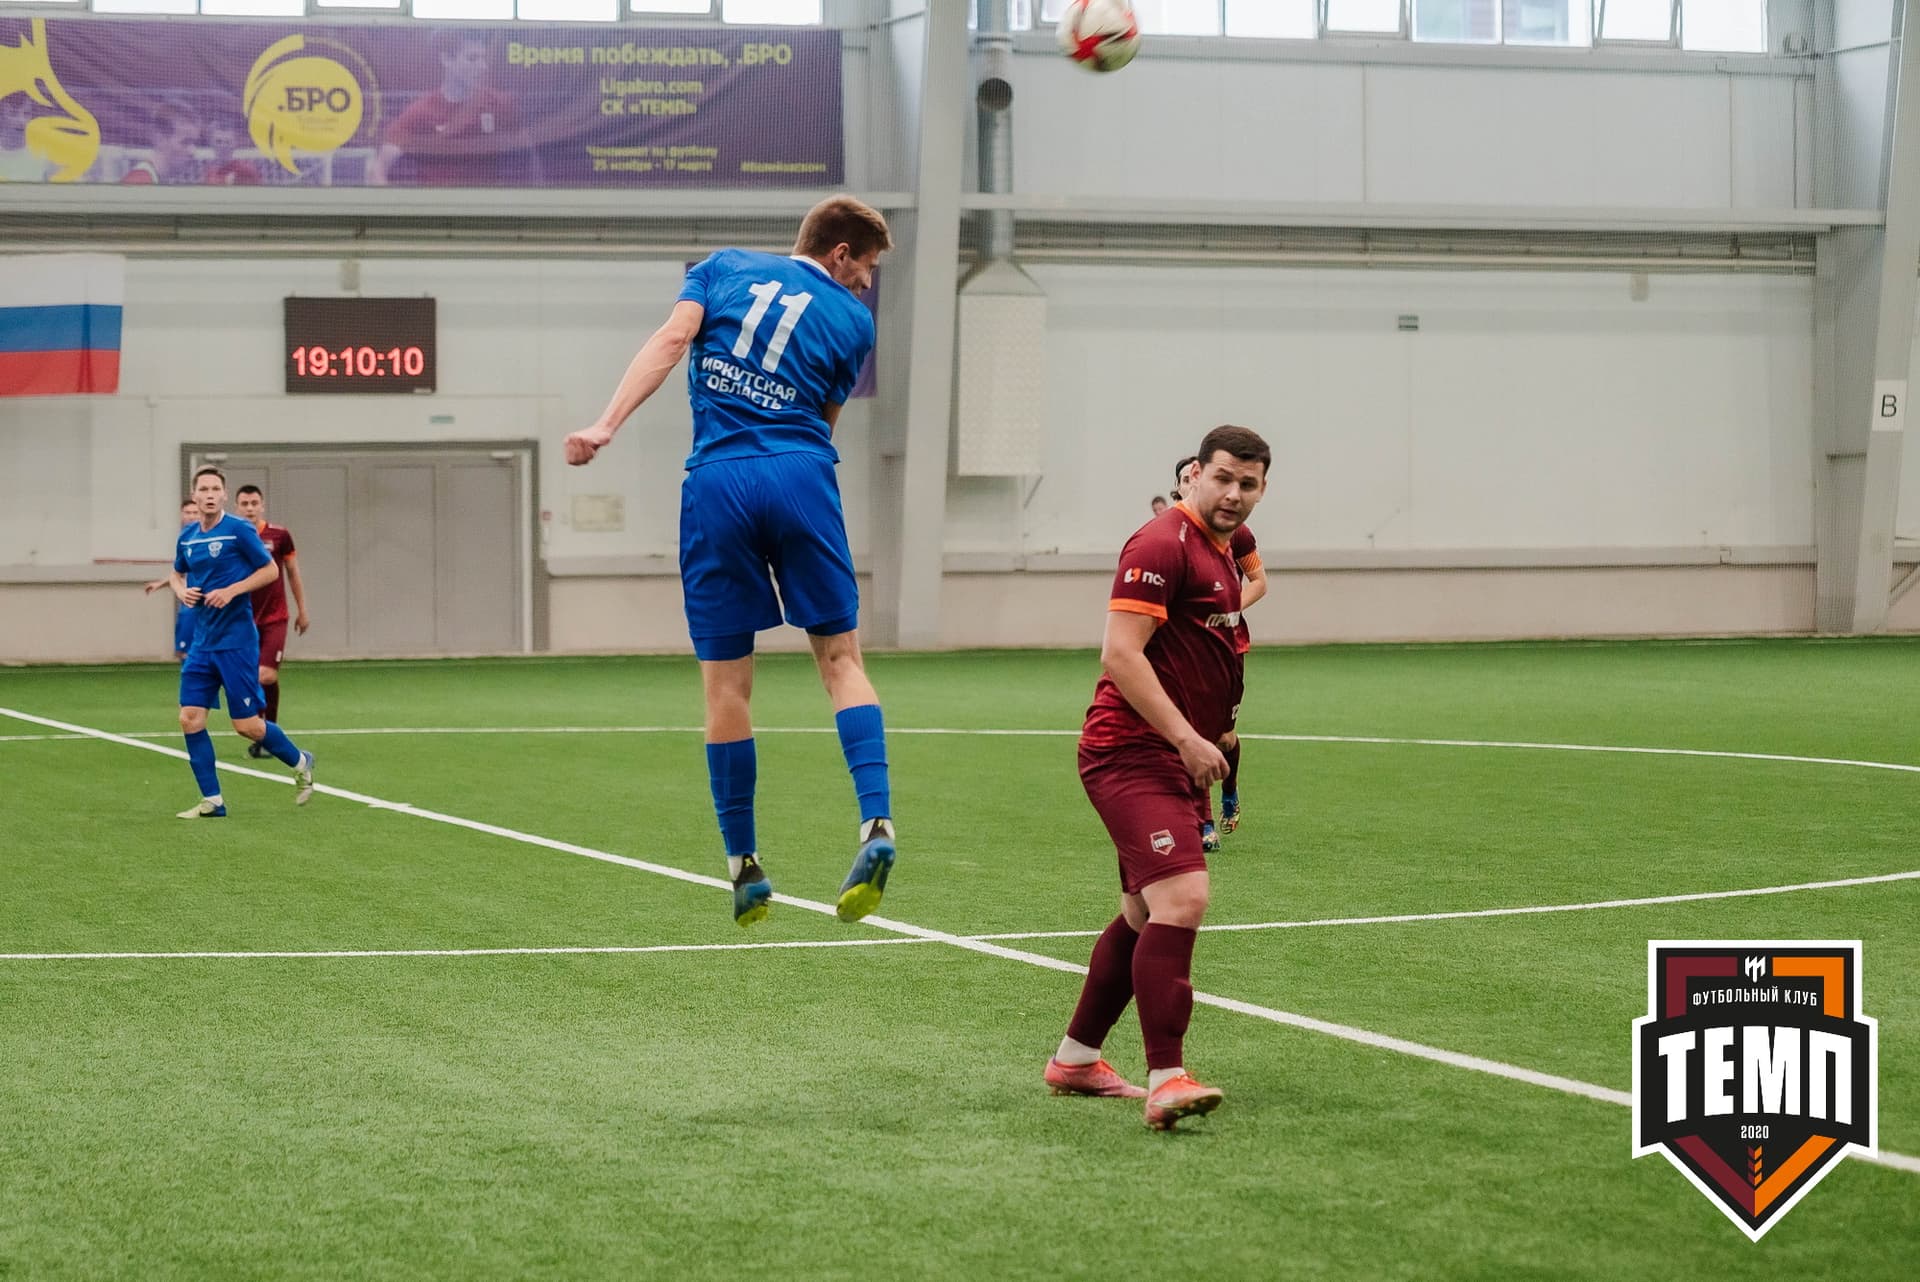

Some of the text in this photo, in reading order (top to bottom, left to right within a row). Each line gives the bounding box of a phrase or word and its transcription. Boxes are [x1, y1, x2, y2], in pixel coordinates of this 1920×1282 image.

[508, 43, 584, 68] Время
[592, 42, 729, 68] побеждать,
[278, 86, 351, 113] .БРО
[601, 78, 704, 97] Ligabro.com
[601, 100, 698, 116] СК «ТЕМП»
[731, 279, 814, 374] 11
[291, 346, 425, 377] 19:10:10
[702, 356, 797, 402] ИРКУТСКАЯ
[706, 374, 783, 411] ОБЛАСТЬ
